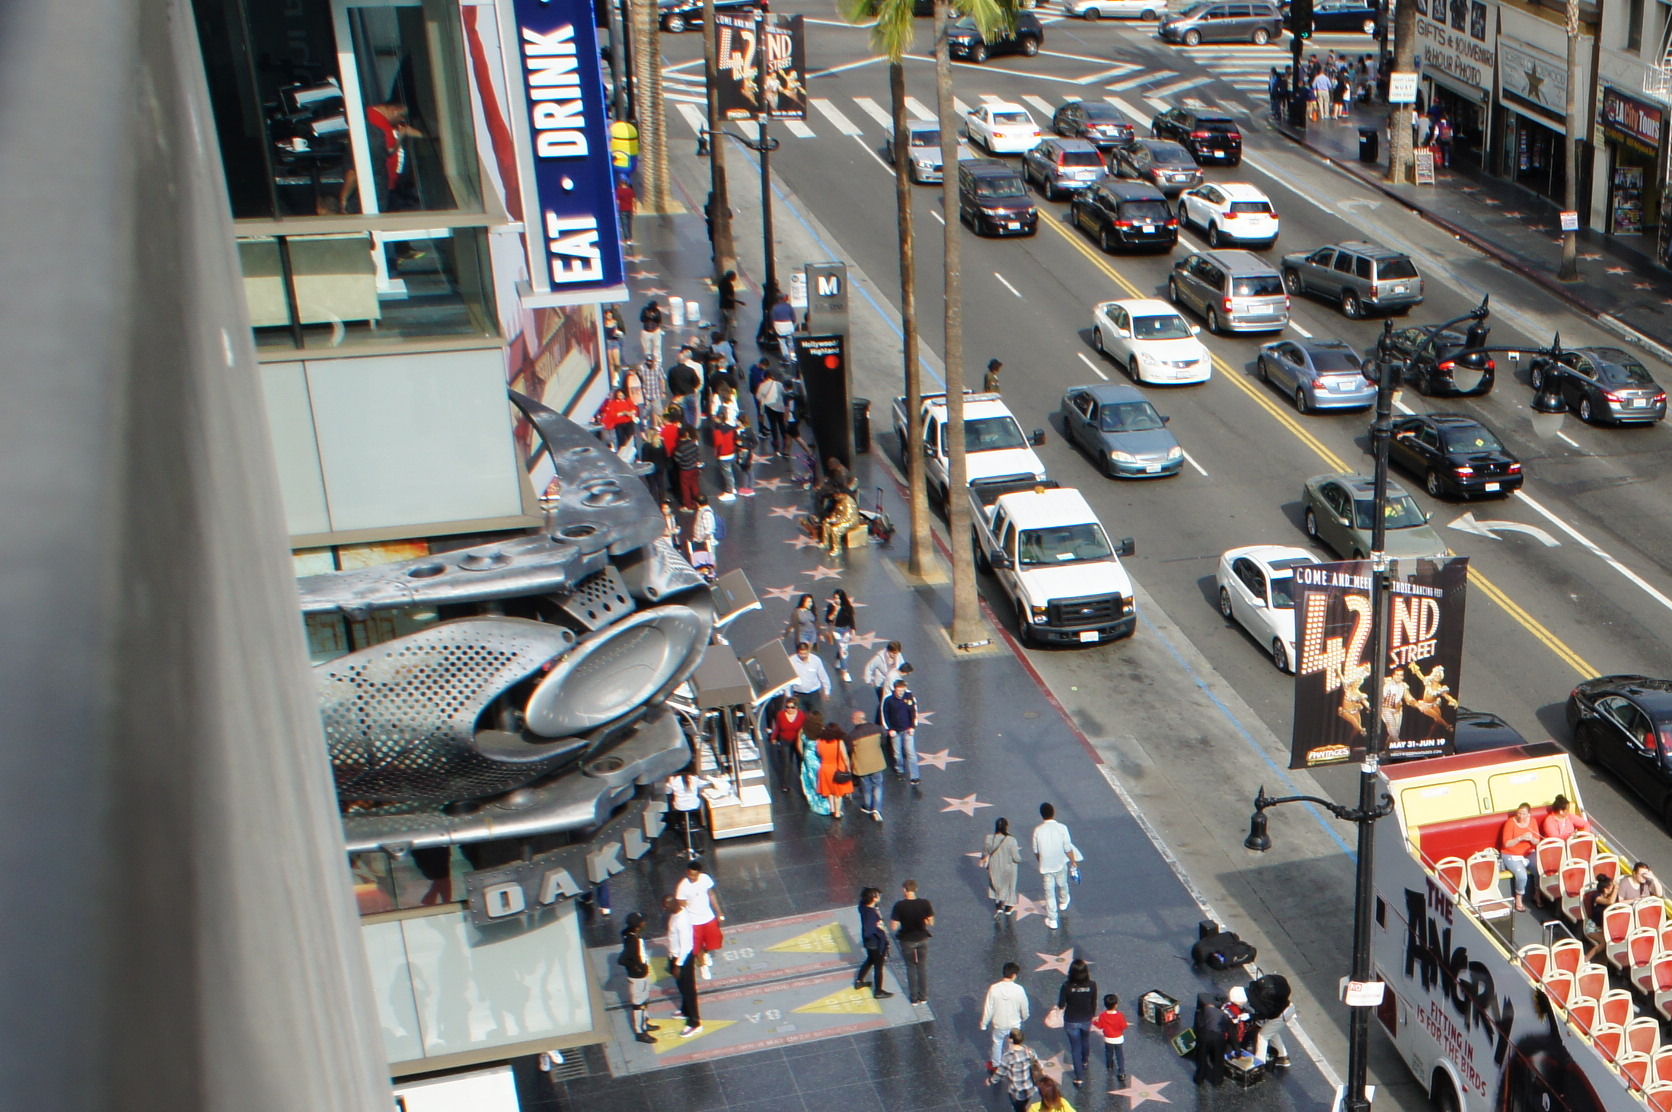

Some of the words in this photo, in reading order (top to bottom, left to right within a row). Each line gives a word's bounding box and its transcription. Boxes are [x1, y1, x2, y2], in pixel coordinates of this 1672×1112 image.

[767, 33, 793, 61] ND
[1416, 18, 1446, 46] GIFTS
[1455, 35, 1494, 68] SOUVENIRS
[522, 24, 589, 158] DRINK
[1454, 55, 1482, 86] PHOTO
[546, 209, 603, 283] EAT
[1297, 568, 1327, 586] COME
[1332, 572, 1350, 587] AND
[1393, 581, 1412, 594] THOSE
[1413, 585, 1434, 596] DANCING
[1301, 594, 1373, 694] 42
[1393, 596, 1440, 648] ND
[1390, 639, 1437, 669] STREET
[1309, 748, 1350, 760] PANTAGES
[1389, 740, 1405, 749] MAY
[1436, 738, 1445, 747] 19
[1425, 877, 1453, 925] THE
[1404, 887, 1514, 1065] ANGRY
[1416, 1005, 1426, 1026] IS
[1426, 1020, 1443, 1046] FOR
[1442, 1037, 1460, 1067] THE
[1460, 1059, 1487, 1098] BIRDS
[1430, 1001, 1464, 1049] FITTING
[1462, 1041, 1474, 1063] IN
